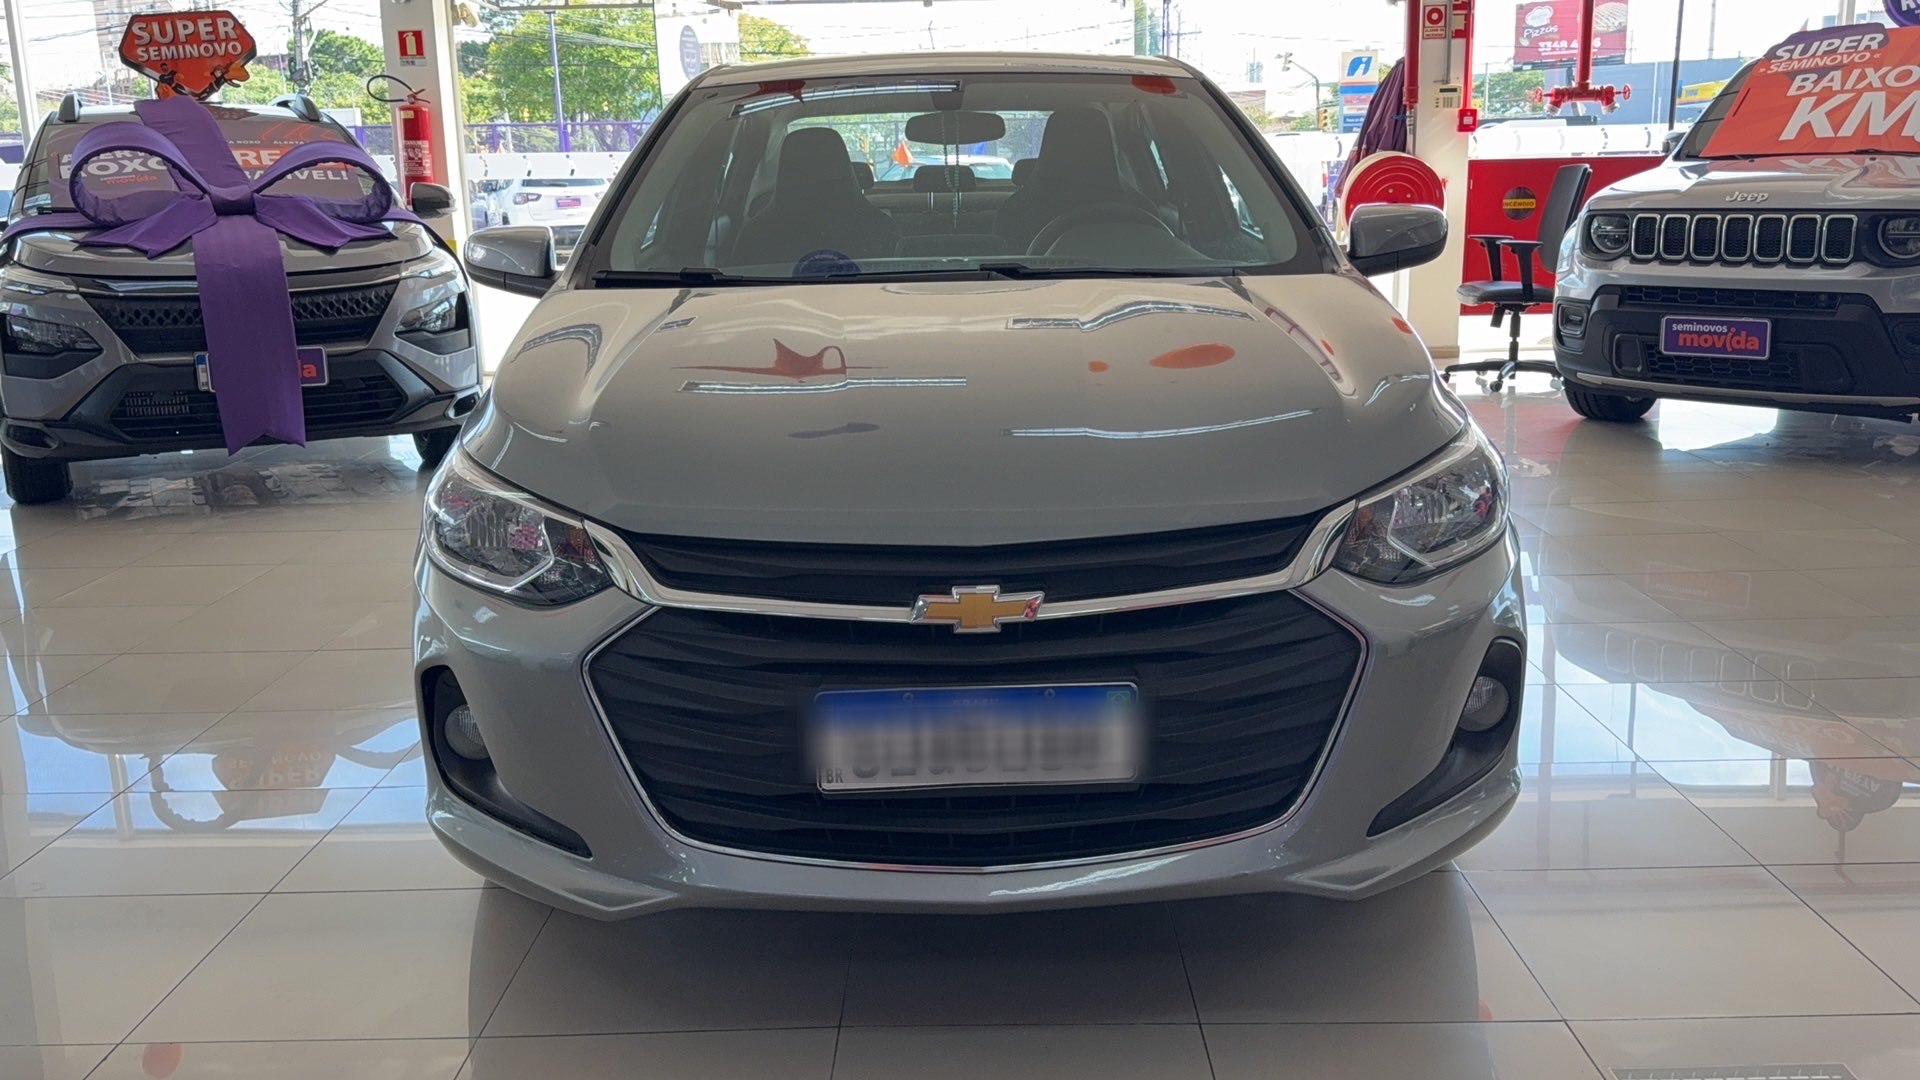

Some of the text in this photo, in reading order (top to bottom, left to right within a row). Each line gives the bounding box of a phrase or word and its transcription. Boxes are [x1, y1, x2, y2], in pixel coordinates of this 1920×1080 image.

[131, 18, 238, 45] SUPER
[136, 41, 242, 61] SEMINOVO
[1771, 33, 1884, 63] SUPER
[1767, 52, 1870, 74] SEMINOVO
[1786, 65, 1920, 97] BAIXO
[1778, 90, 1920, 141] KM
[1725, 191, 1769, 203] Jeep
[1672, 322, 1728, 333] seminovos
[1678, 327, 1760, 352] movida
[826, 767, 844, 784] BR
